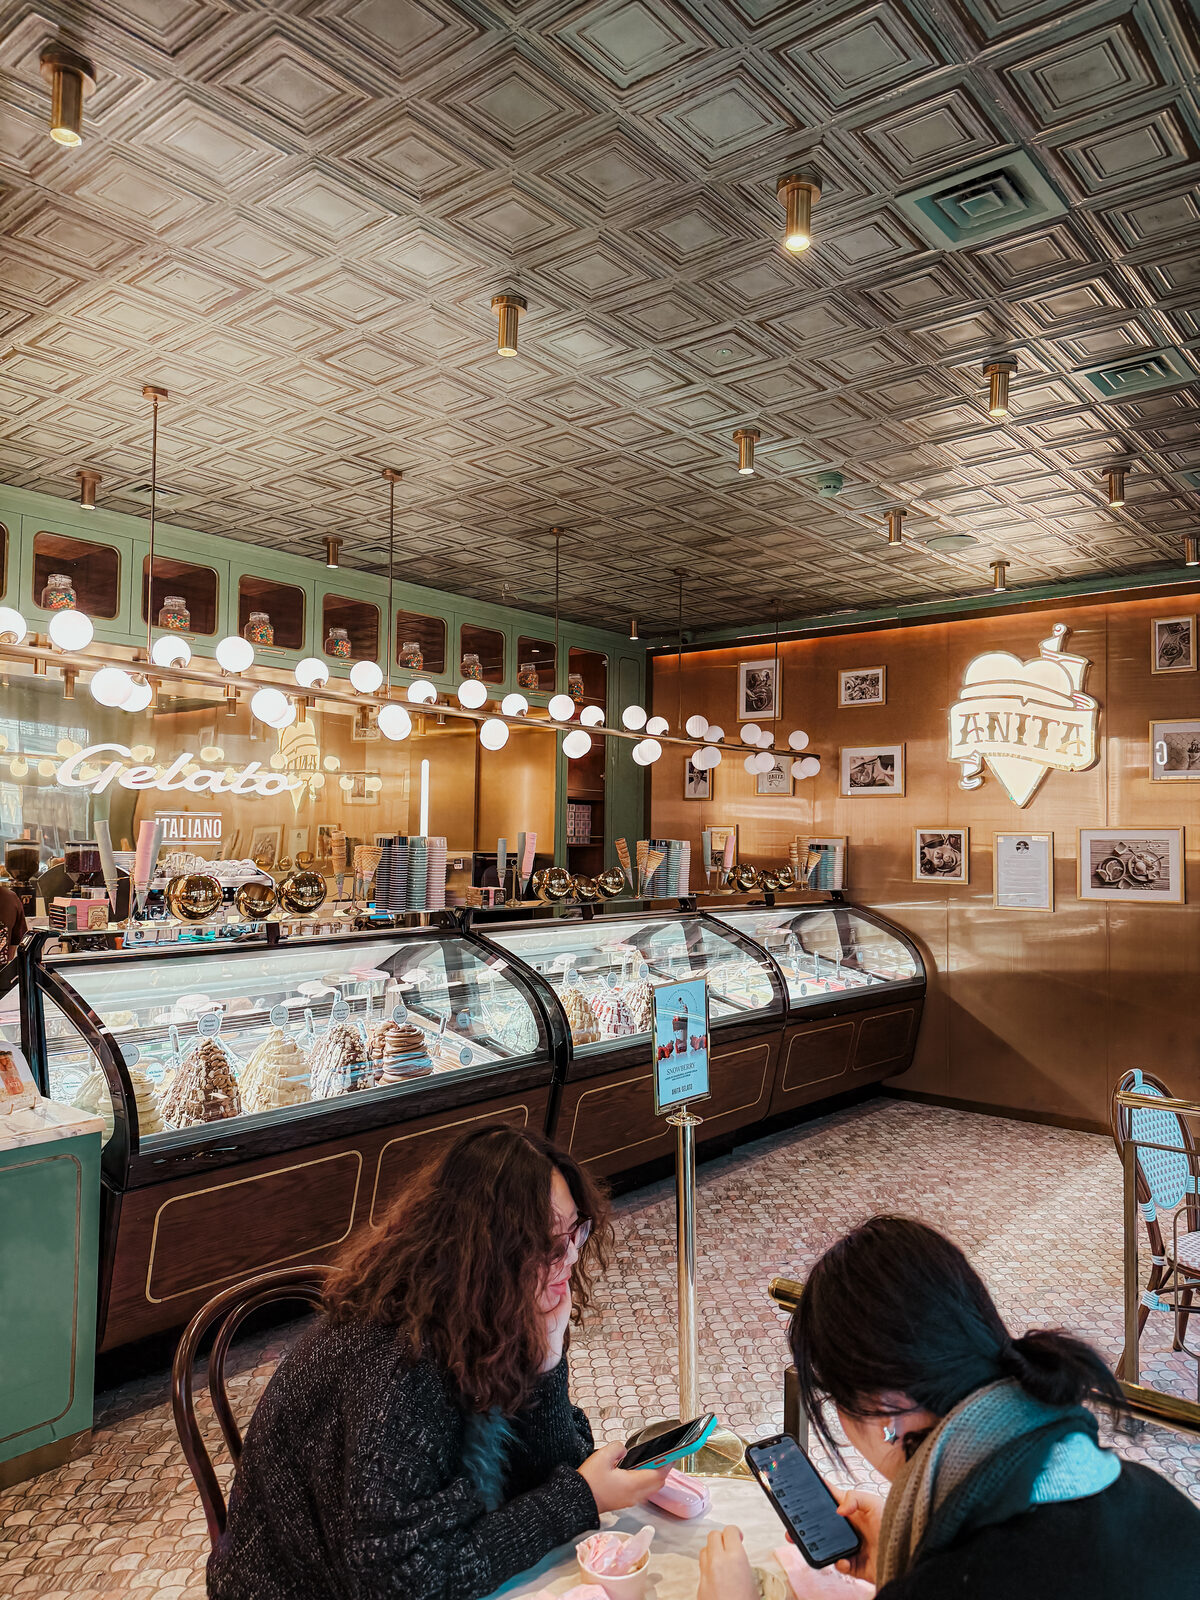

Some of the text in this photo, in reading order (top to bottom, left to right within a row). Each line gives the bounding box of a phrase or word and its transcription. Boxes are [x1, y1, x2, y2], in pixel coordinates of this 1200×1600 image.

[955, 711, 1086, 757] ANITA
[56, 743, 304, 796] Gelato
[666, 1062, 695, 1075] SNOWBERRY
